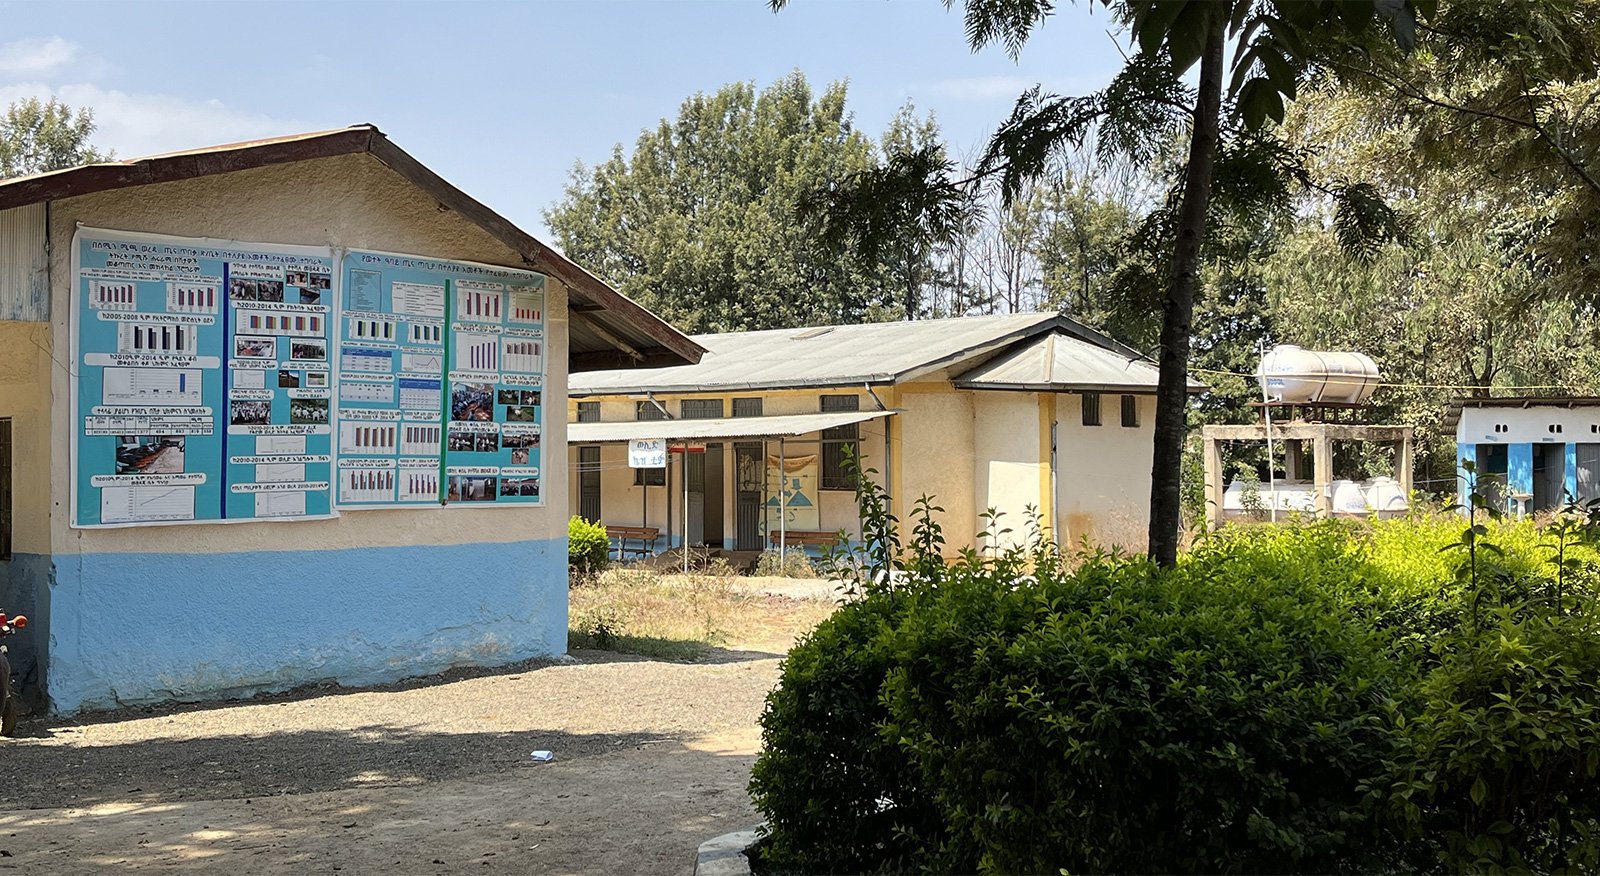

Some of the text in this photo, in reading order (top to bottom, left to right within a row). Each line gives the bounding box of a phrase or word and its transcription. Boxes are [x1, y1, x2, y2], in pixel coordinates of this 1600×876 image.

[164, 247, 177, 255] ጤና
[180, 248, 198, 257] ጥበቃ
[402, 259, 415, 268] ጤና
[417, 261, 436, 270] ጣቢያ
